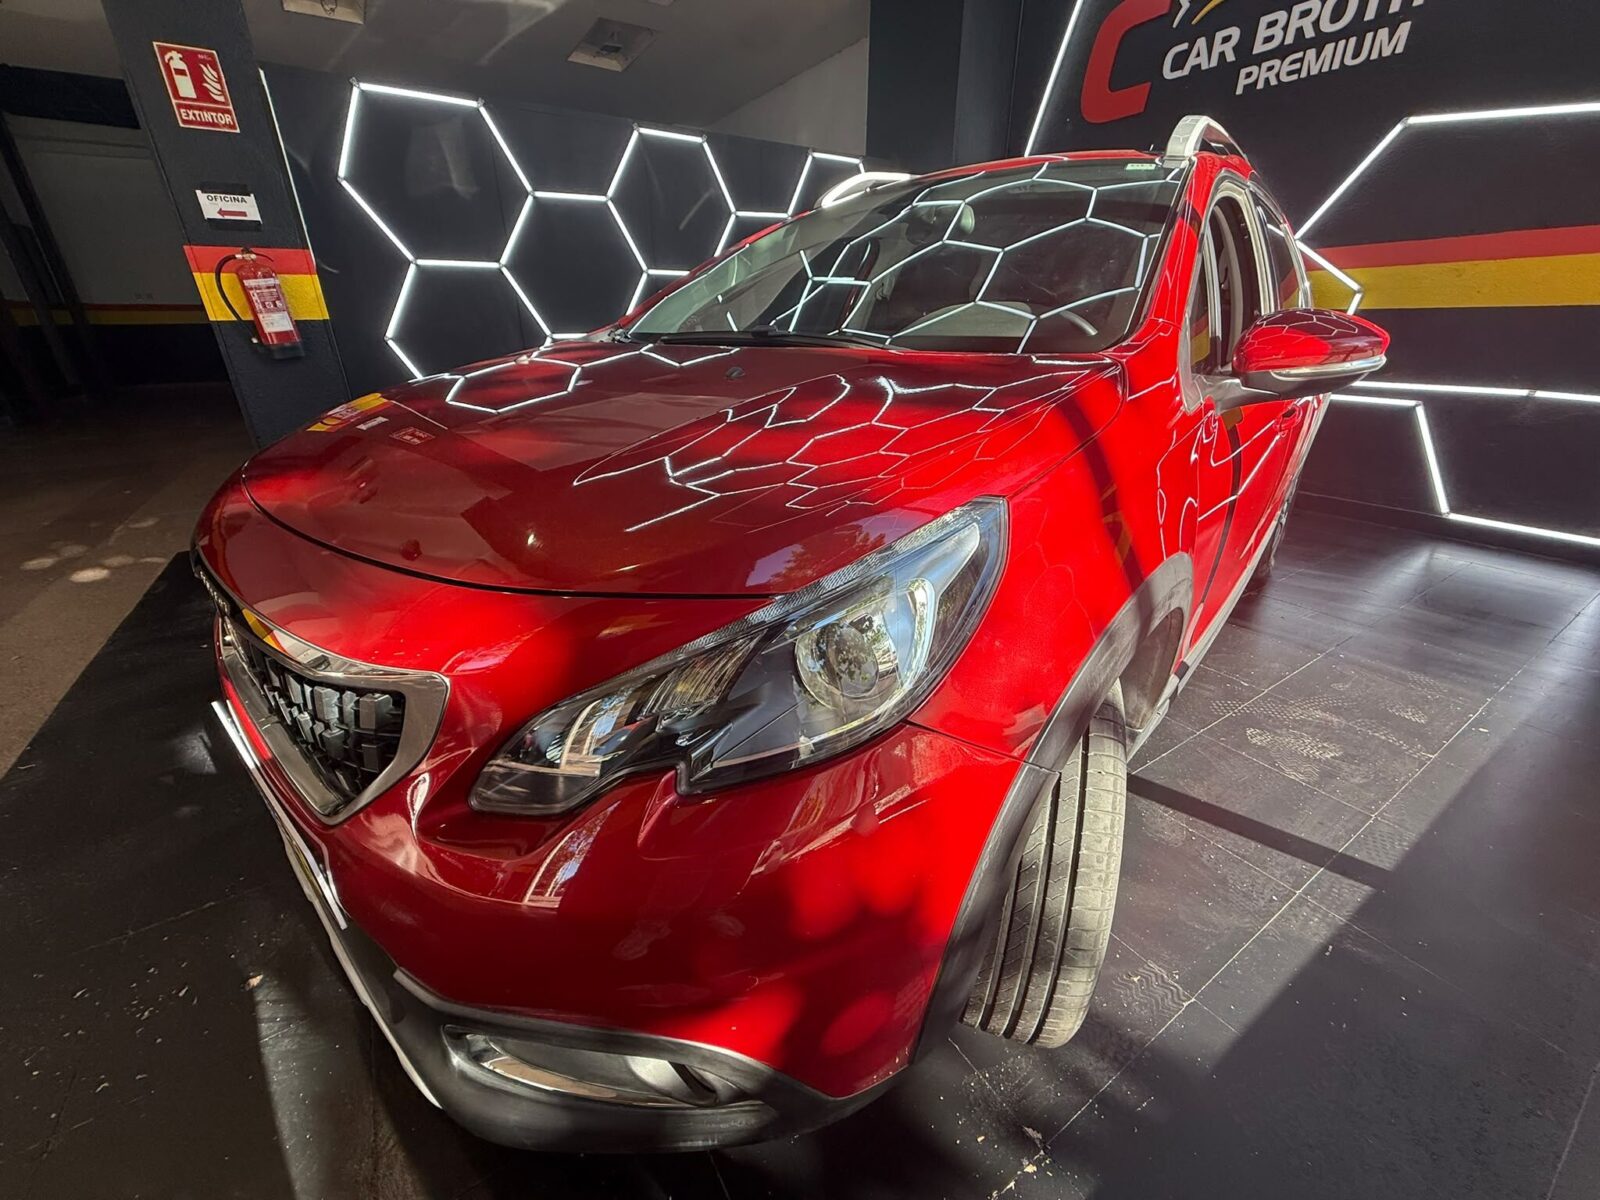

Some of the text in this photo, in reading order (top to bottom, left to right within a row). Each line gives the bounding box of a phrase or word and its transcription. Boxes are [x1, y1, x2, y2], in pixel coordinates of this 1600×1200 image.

[1163, 0, 1424, 79] CAR BRO
[1235, 21, 1412, 95] PREMIUM
[180, 108, 233, 125] EXTINTOR
[206, 194, 248, 204] OFICINA
